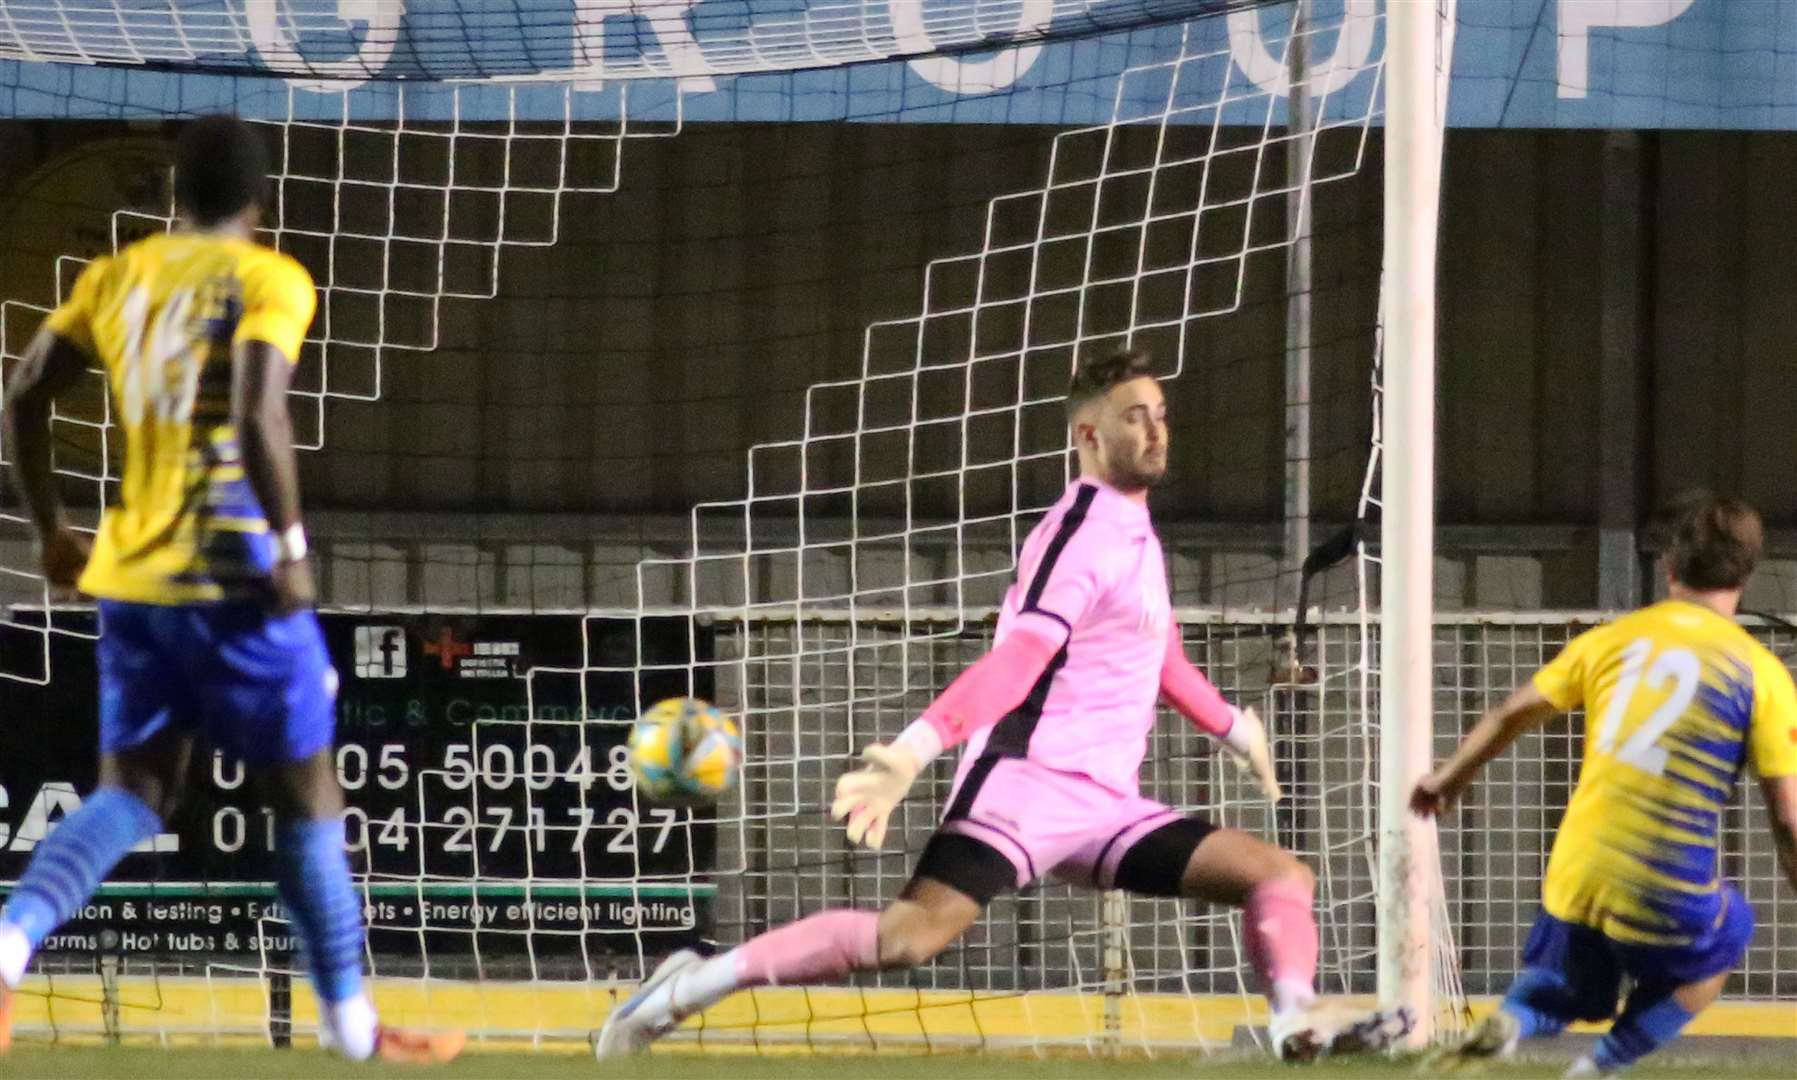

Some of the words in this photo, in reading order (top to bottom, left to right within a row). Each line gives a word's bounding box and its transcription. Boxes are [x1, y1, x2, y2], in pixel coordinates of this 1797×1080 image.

[446, 699, 634, 727] Commerc
[1597, 637, 1700, 776] 12
[443, 744, 634, 790] 50048
[443, 807, 677, 853] 271727
[122, 902, 138, 920] &
[422, 903, 497, 925] Energy
[506, 903, 600, 922] efficient
[610, 903, 695, 925] lighting
[169, 932, 214, 951] tubs
[225, 933, 240, 951] &
